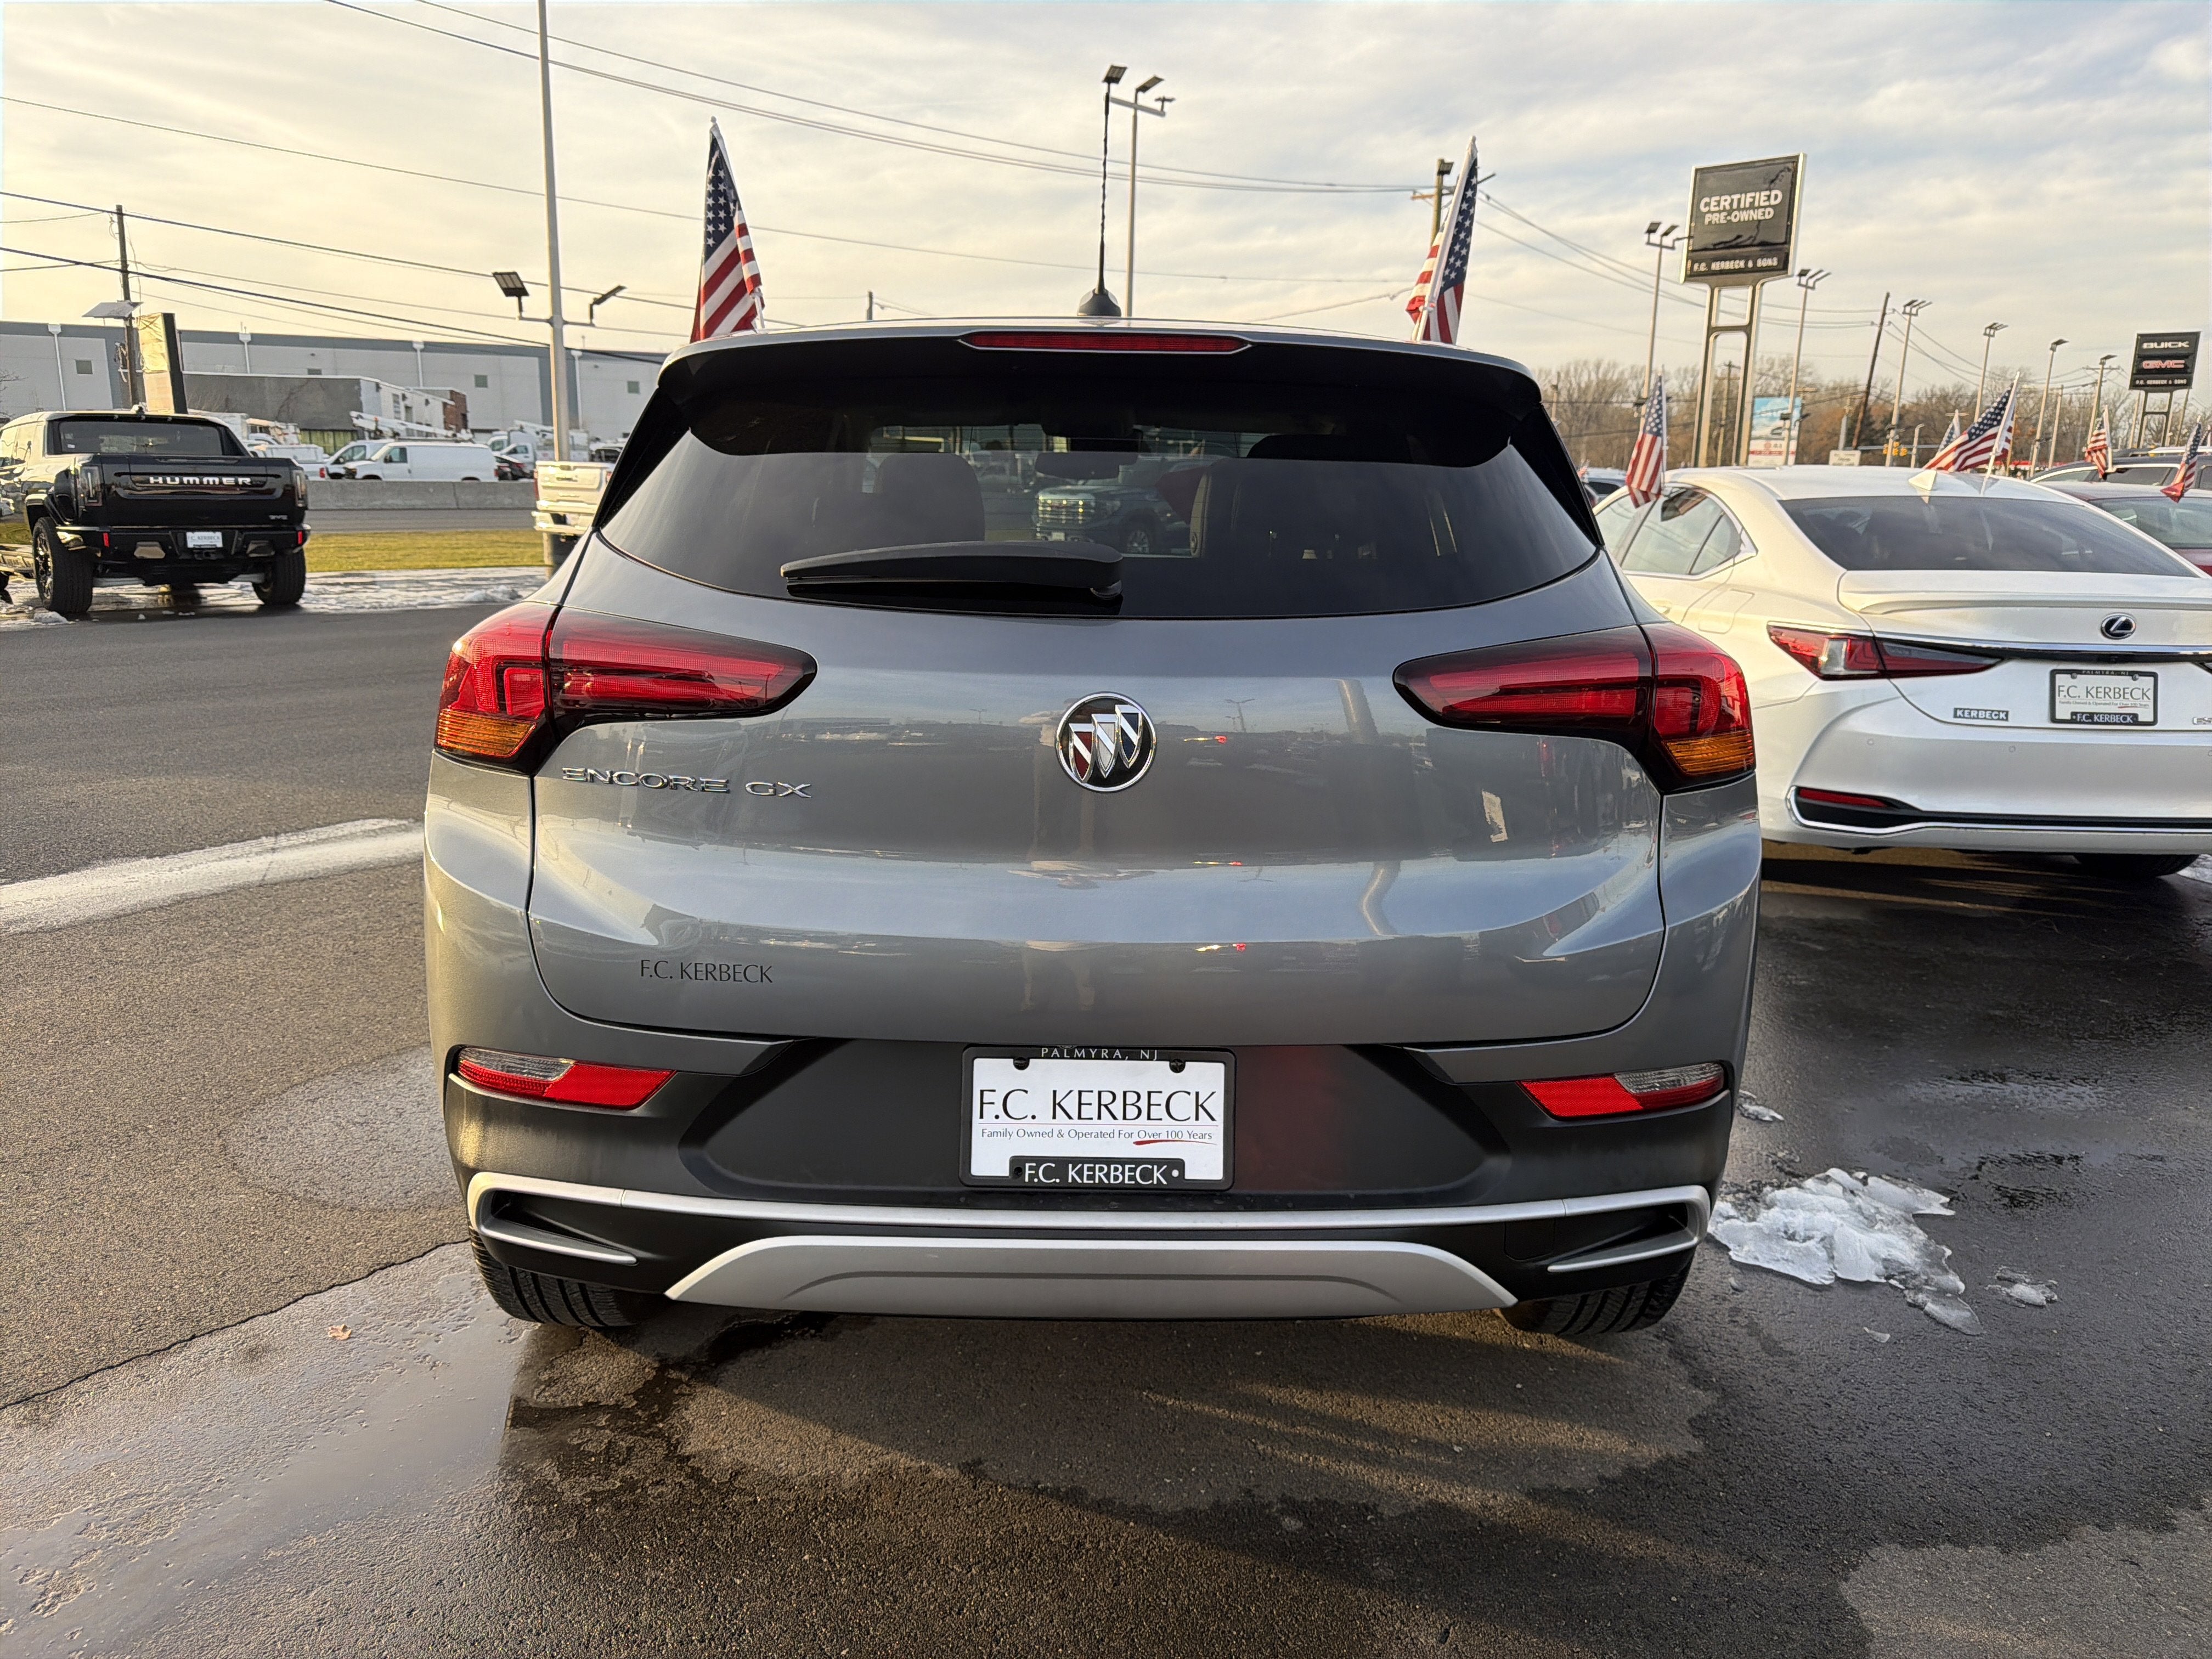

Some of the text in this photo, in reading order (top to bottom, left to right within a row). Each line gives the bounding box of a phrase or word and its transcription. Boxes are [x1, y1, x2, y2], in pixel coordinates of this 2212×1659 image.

[1700, 190, 1782, 212] CERTIFIED
[1705, 207, 1774, 225] PRE-OWNED
[2142, 360, 2185, 369] GMC
[149, 476, 251, 486] HUMMER
[2058, 685, 2151, 701] F.C. KERBECK
[1956, 709, 2006, 720] KERBECK
[2077, 714, 2133, 723] F.C. KERBECK
[562, 766, 812, 798] ENCORE GX
[641, 960, 773, 983] F.C. KERBECK
[1041, 1047, 1157, 1060] PALMYRA, NJ
[979, 1089, 1217, 1121] F.C. KERBECK
[981, 1128, 1212, 1141] Family Owned & Operated For Over 100 Years
[1025, 1163, 1167, 1185] F.C. KERBECK
